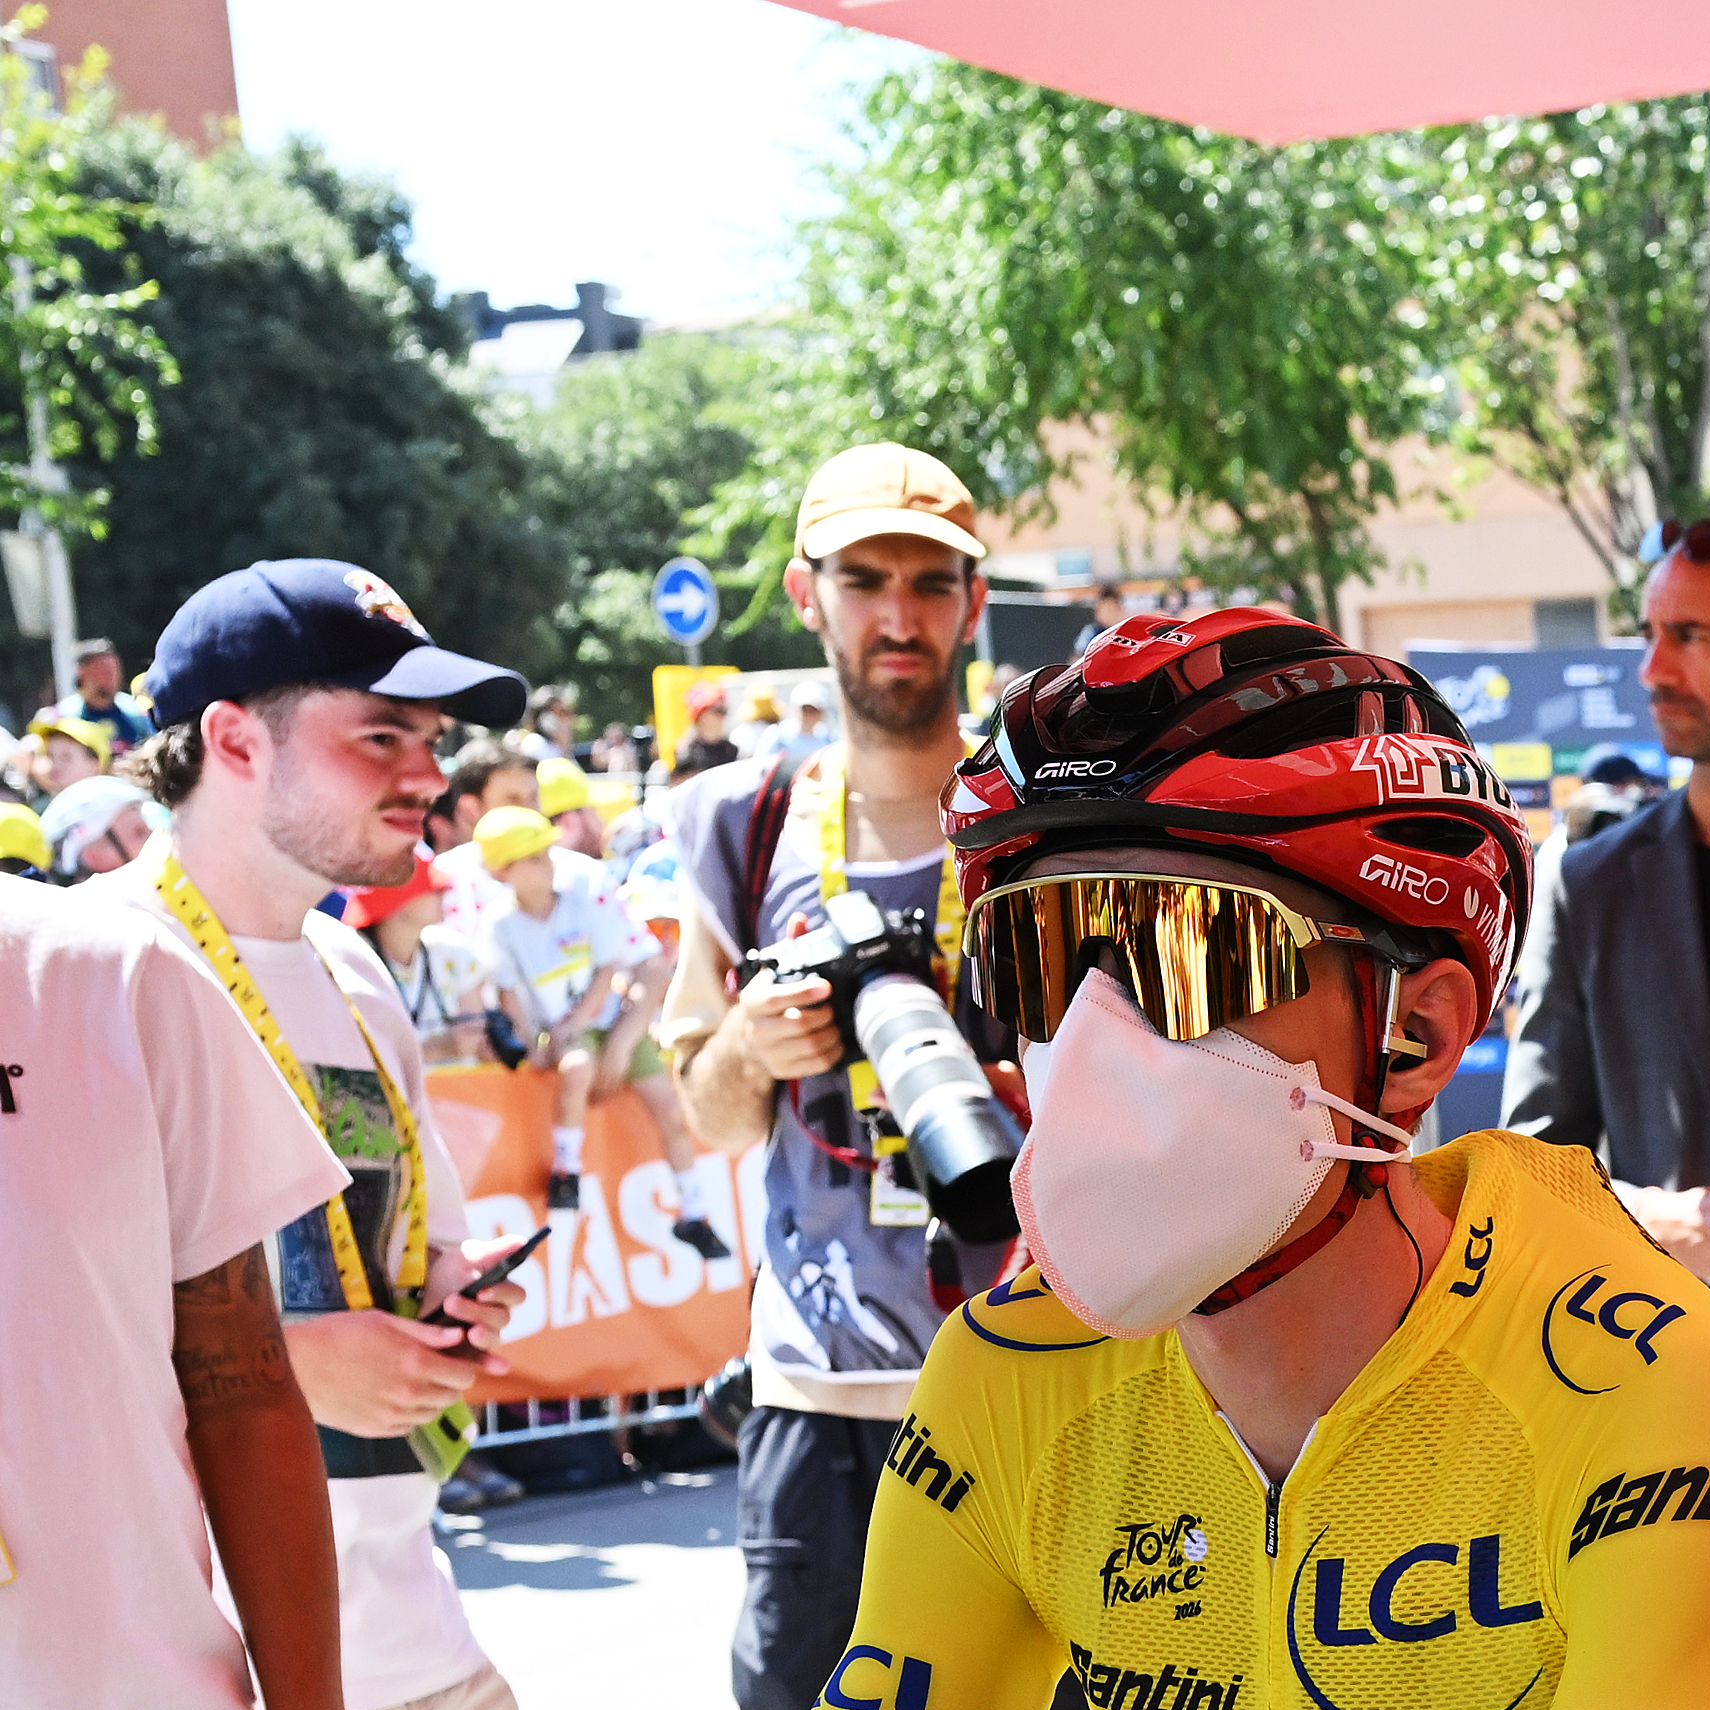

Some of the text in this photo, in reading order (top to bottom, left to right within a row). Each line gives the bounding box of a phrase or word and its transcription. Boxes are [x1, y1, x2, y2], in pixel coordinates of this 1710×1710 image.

[1034, 758, 1117, 780] GIRO
[1359, 853, 1450, 906] GIRO
[1448, 1215, 1495, 1299] LCL
[1565, 1273, 1688, 1367] LCL
[1265, 1513, 1279, 1556] Santini
[1174, 1598, 1203, 1621] 2026
[1312, 1533, 1544, 1649] LCL
